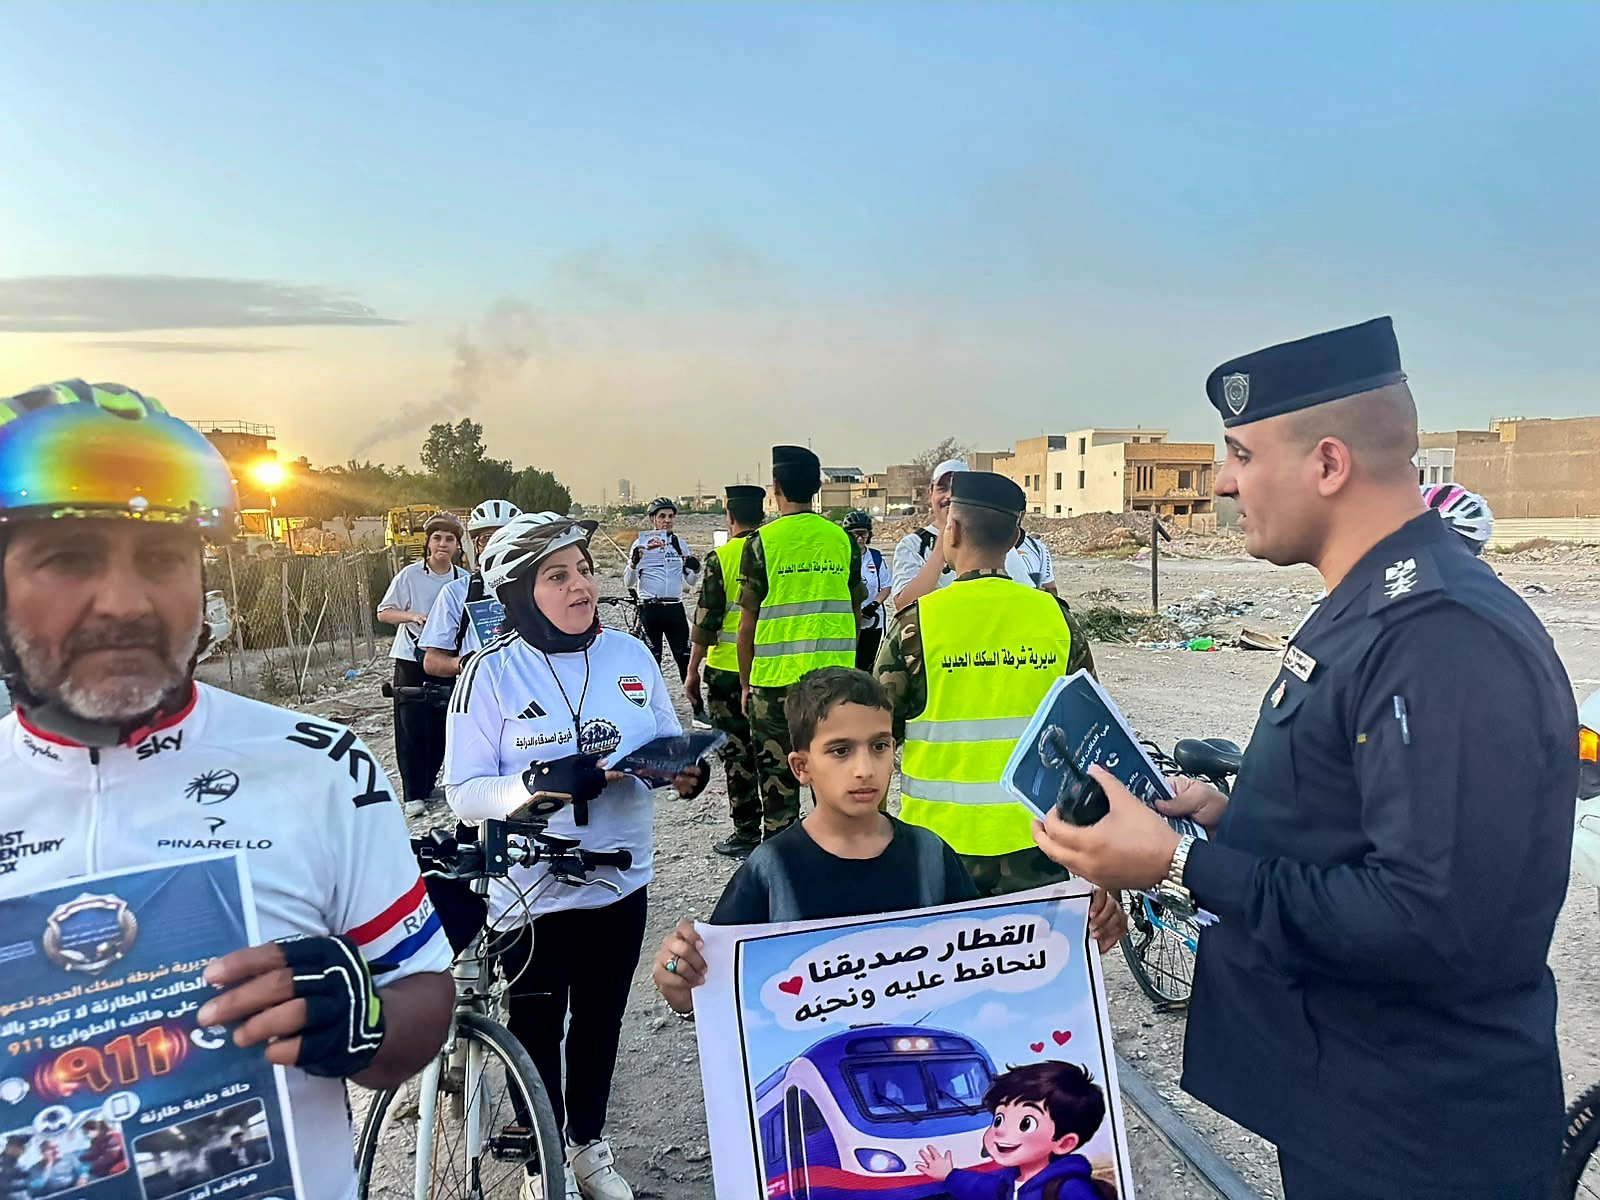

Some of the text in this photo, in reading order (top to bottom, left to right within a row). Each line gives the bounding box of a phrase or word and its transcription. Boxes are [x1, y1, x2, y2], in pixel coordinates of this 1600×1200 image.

[941, 645, 1057, 673] مديرية شرطة السكك الحديد
[516, 736, 534, 750] الدراجة
[557, 727, 573, 745] فريق
[0, 838, 65, 860] ENTURY
[157, 838, 273, 850] PINARELLO
[403, 898, 434, 935] RAP
[808, 923, 1036, 984] القطار صديقنا
[126, 964, 170, 983] شرطة
[37, 984, 82, 1006] الحديد
[84, 978, 124, 995] سكك
[150, 976, 208, 1000] الحالات
[883, 970, 946, 1000] عليه
[74, 1003, 88, 1020] لا
[91, 989, 148, 1015] الطارئة
[8, 1000, 199, 1057] على هاتف الطوارئ 911
[29, 1008, 71, 1030] تتردد
[53, 1025, 171, 1092] 911
[220, 1082, 251, 1098] حالة
[182, 1092, 219, 1111] طبية
[212, 1173, 258, 1194] موقف
